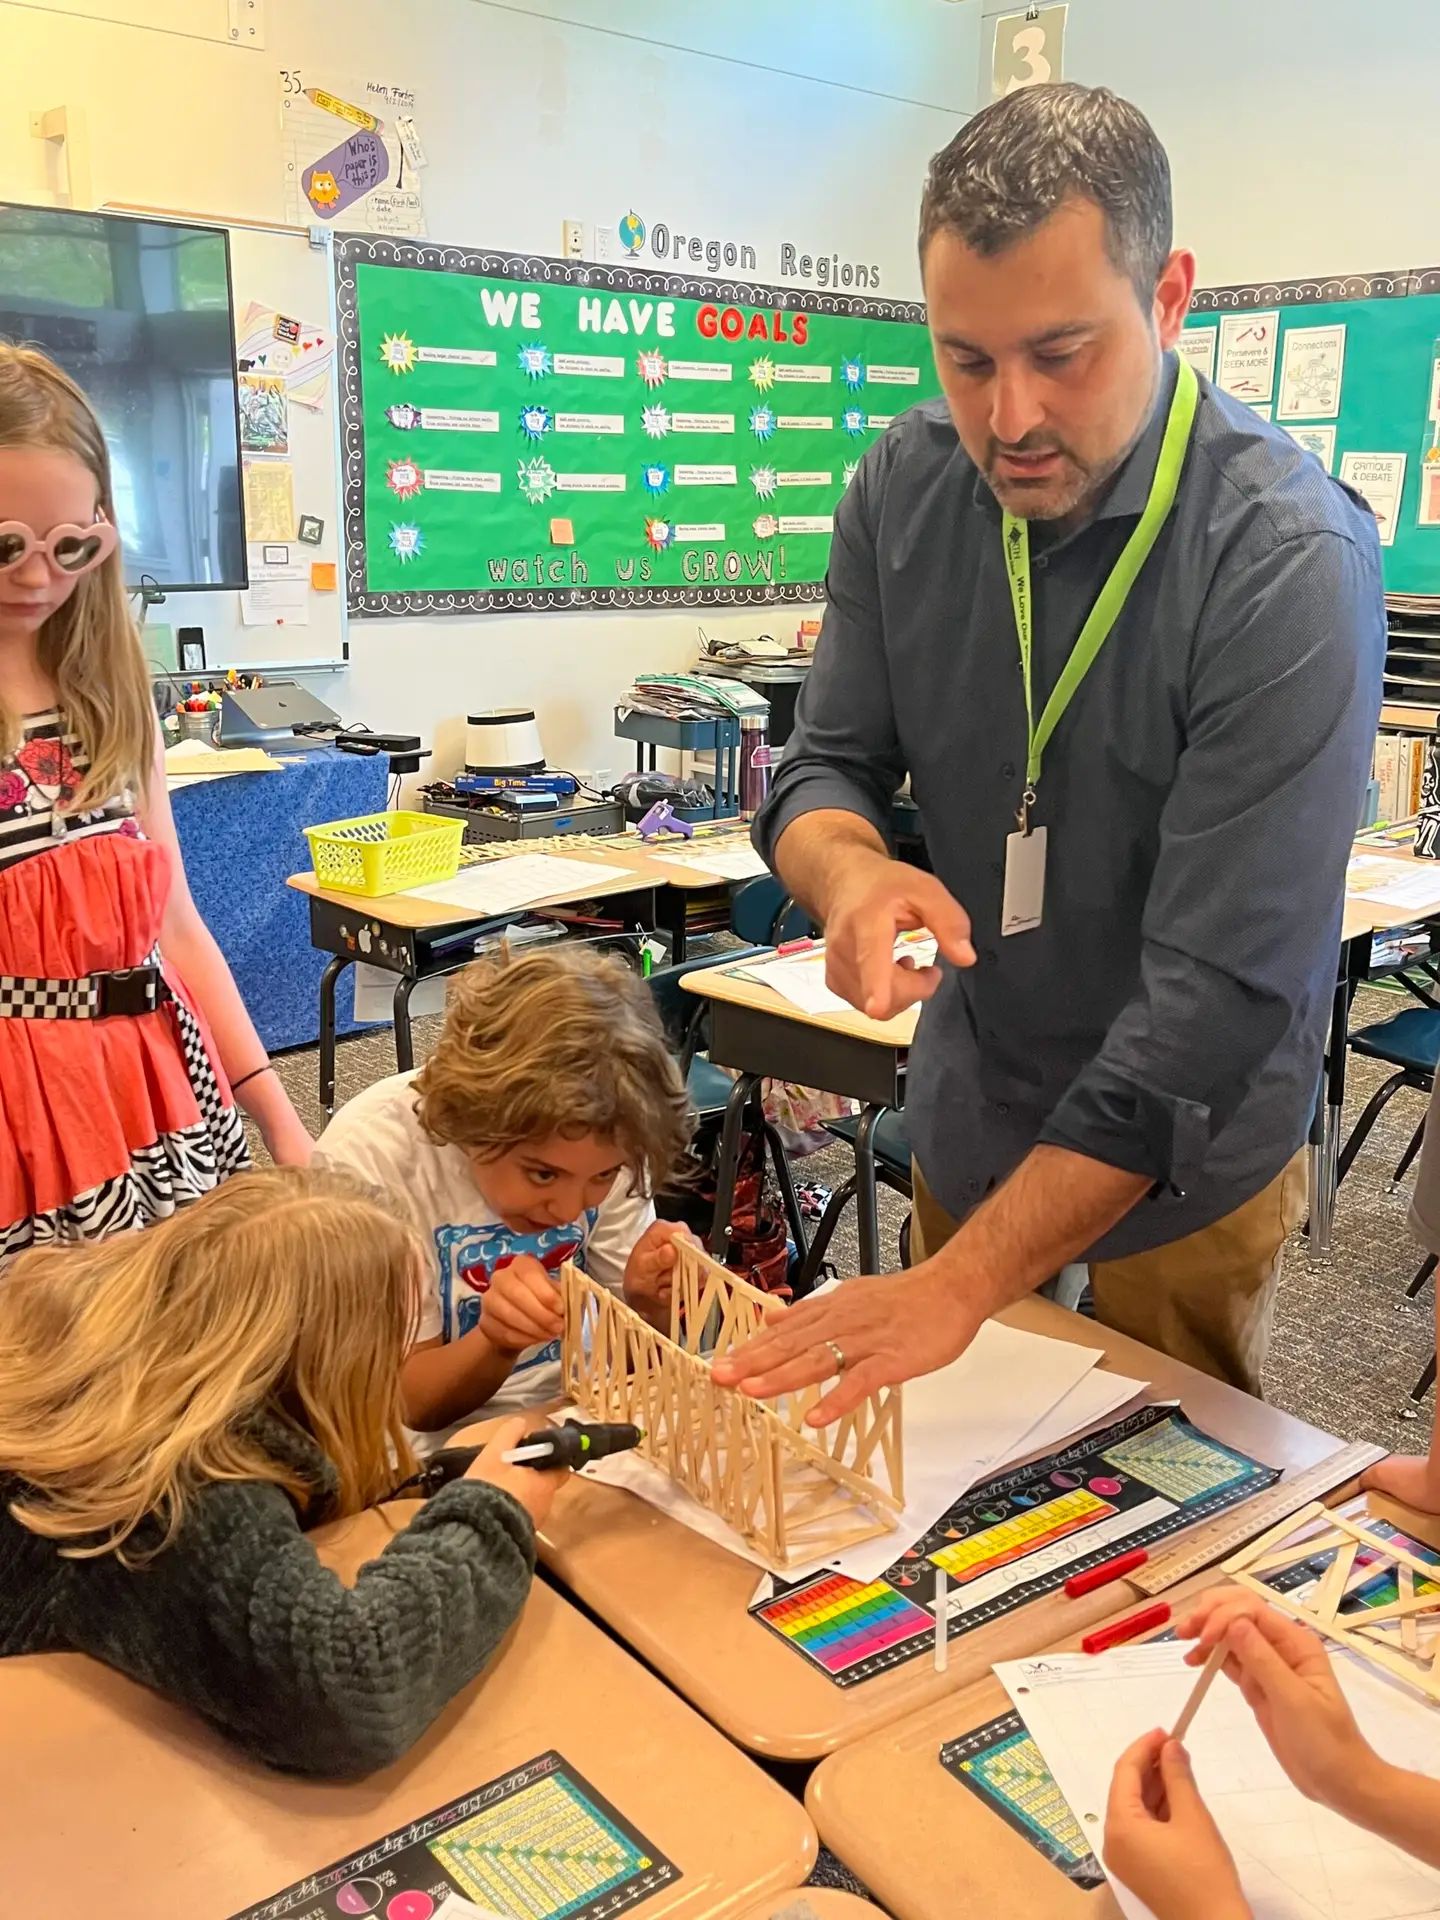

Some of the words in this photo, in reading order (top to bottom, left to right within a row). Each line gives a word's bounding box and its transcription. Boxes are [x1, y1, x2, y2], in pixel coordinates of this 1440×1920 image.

[1004, 26, 1051, 94] 3
[279, 70, 302, 95] 35
[348, 138, 375, 156] Who's
[345, 159, 367, 179] paper
[369, 154, 378, 167] is
[651, 223, 757, 273] Oregon
[780, 242, 881, 289] Regions
[480, 287, 542, 329] WE
[578, 296, 676, 337] HAVE
[696, 303, 809, 346] GOALS
[1291, 340, 1337, 351] Connections
[1223, 360, 1246, 369] SEEK
[1246, 358, 1269, 368] MORE
[1352, 462, 1393, 472] CRITIQUE
[1360, 473, 1393, 482] DEBATE
[487, 550, 588, 585] watch
[615, 556, 652, 582] us
[681, 544, 787, 583] GROW!
[1016, 575, 1025, 593] We
[1018, 595, 1026, 621] Love
[494, 778, 507, 788] Big
[508, 778, 527, 788] Time
